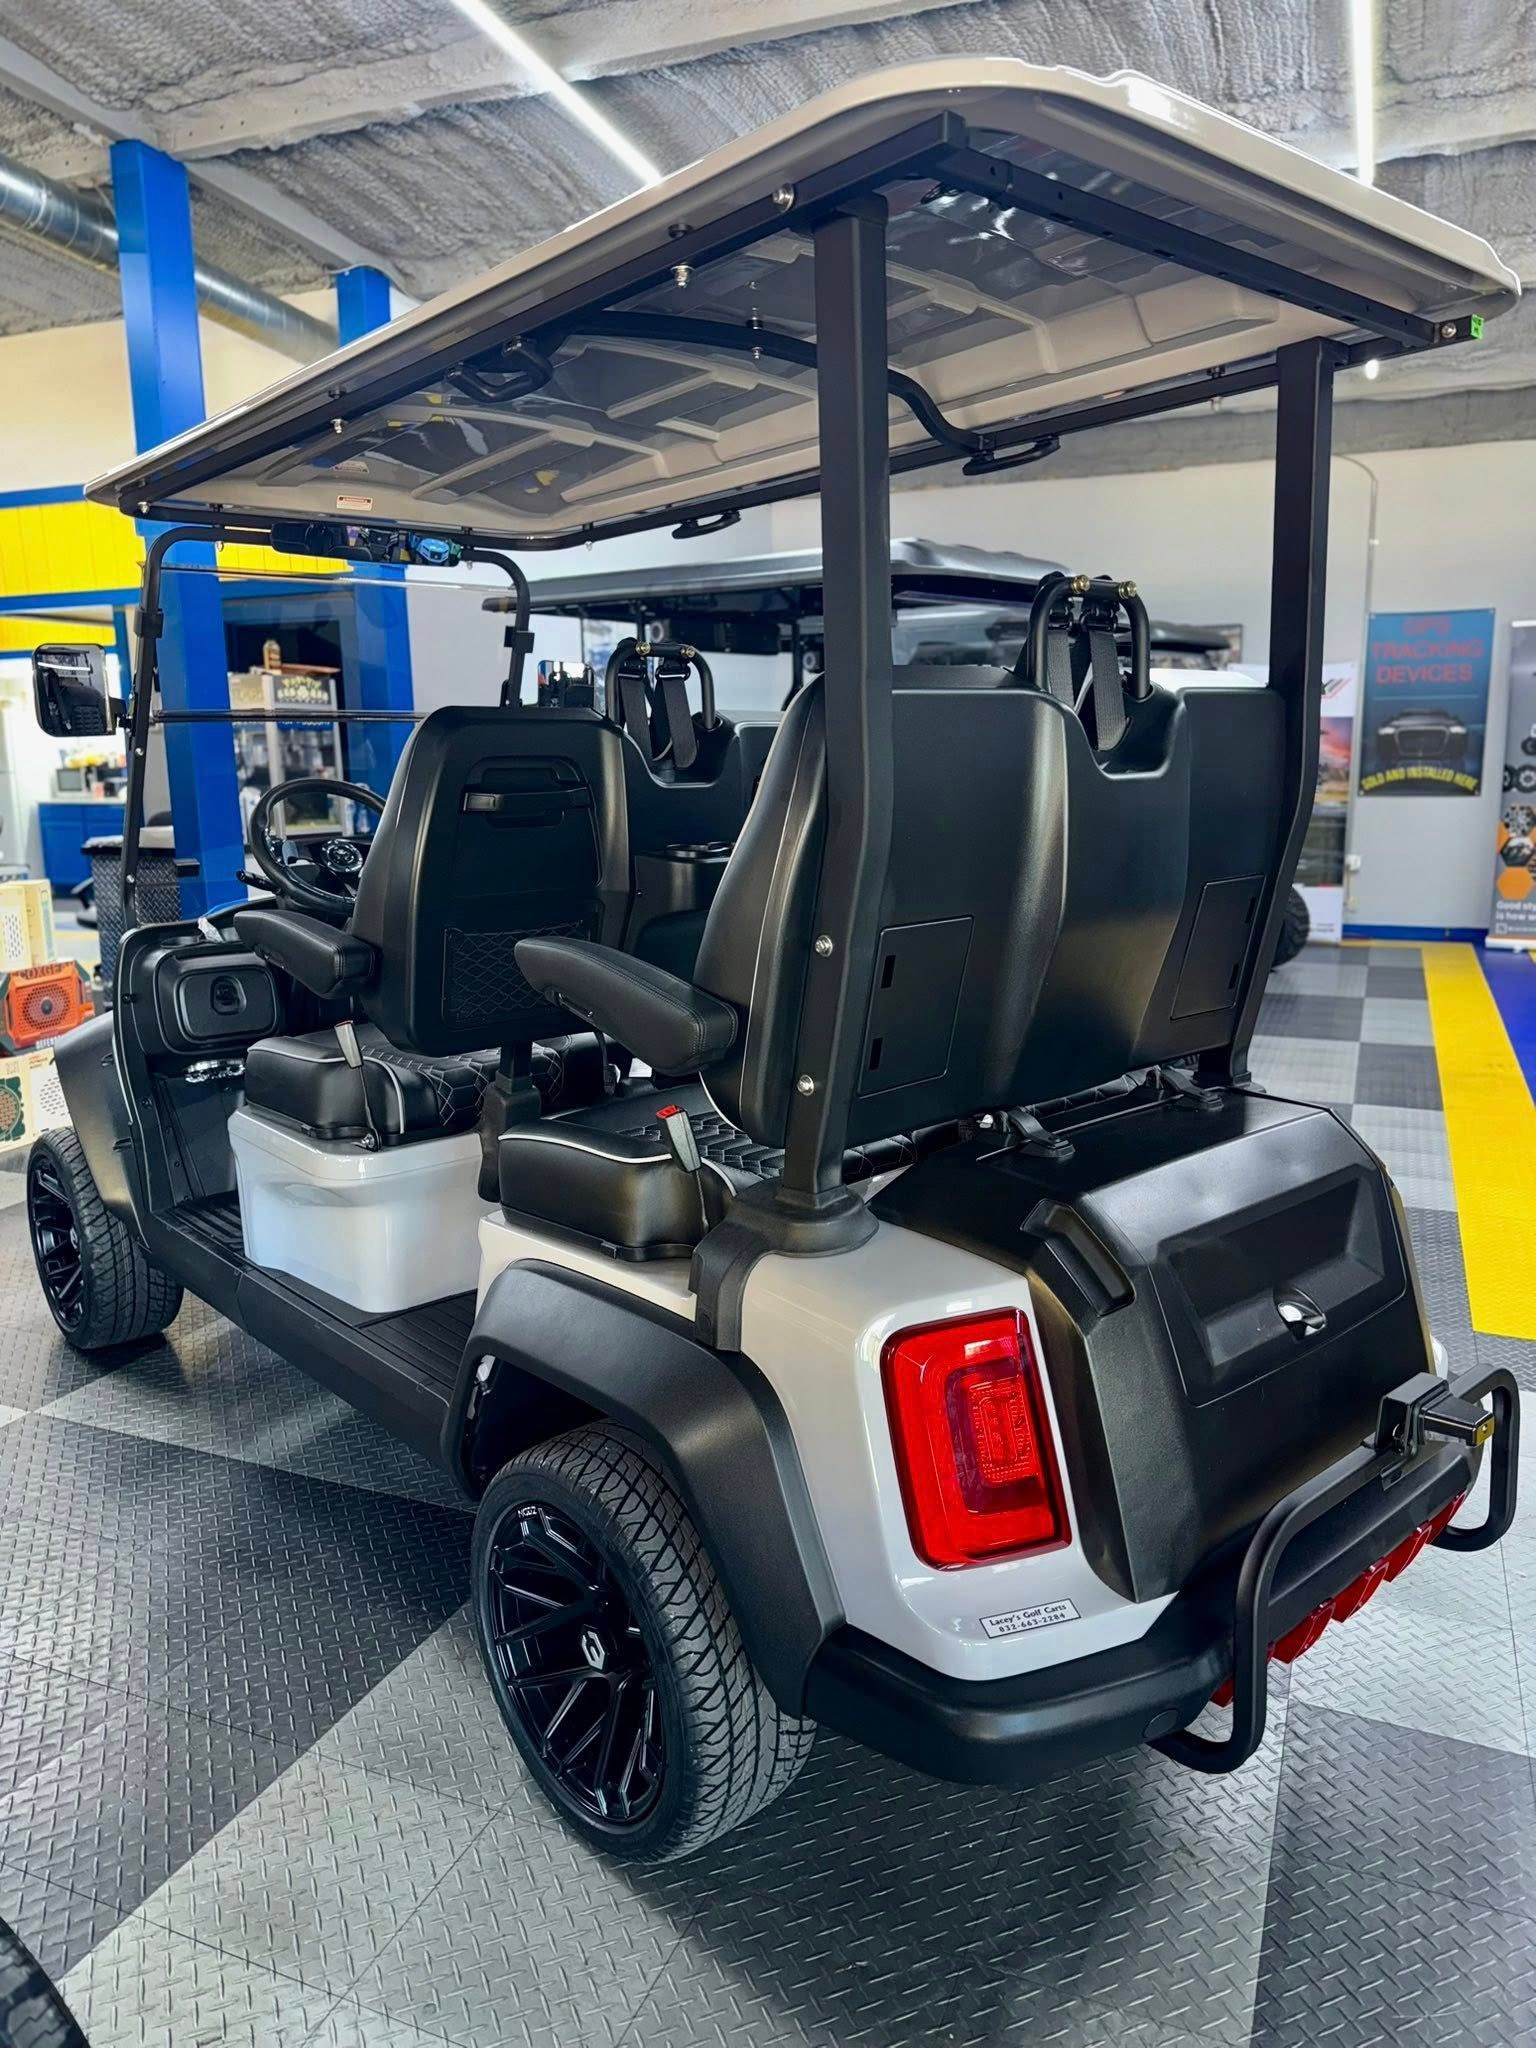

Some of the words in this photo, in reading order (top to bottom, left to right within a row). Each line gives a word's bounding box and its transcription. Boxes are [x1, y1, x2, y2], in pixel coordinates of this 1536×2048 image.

[1373, 639, 1484, 661] TRACKING
[1377, 663, 1472, 685] DEVICES
[1361, 772, 1385, 791] SOLD
[1386, 767, 1406, 782] AND
[1406, 766, 1455, 782] INSTALLED
[1454, 771, 1479, 791] HERE
[989, 1614, 1021, 1627] Lacey's
[1023, 1608, 1042, 1620] Golf
[1044, 1604, 1067, 1614] Carts
[999, 1612, 1066, 1633] 832-663-2284
